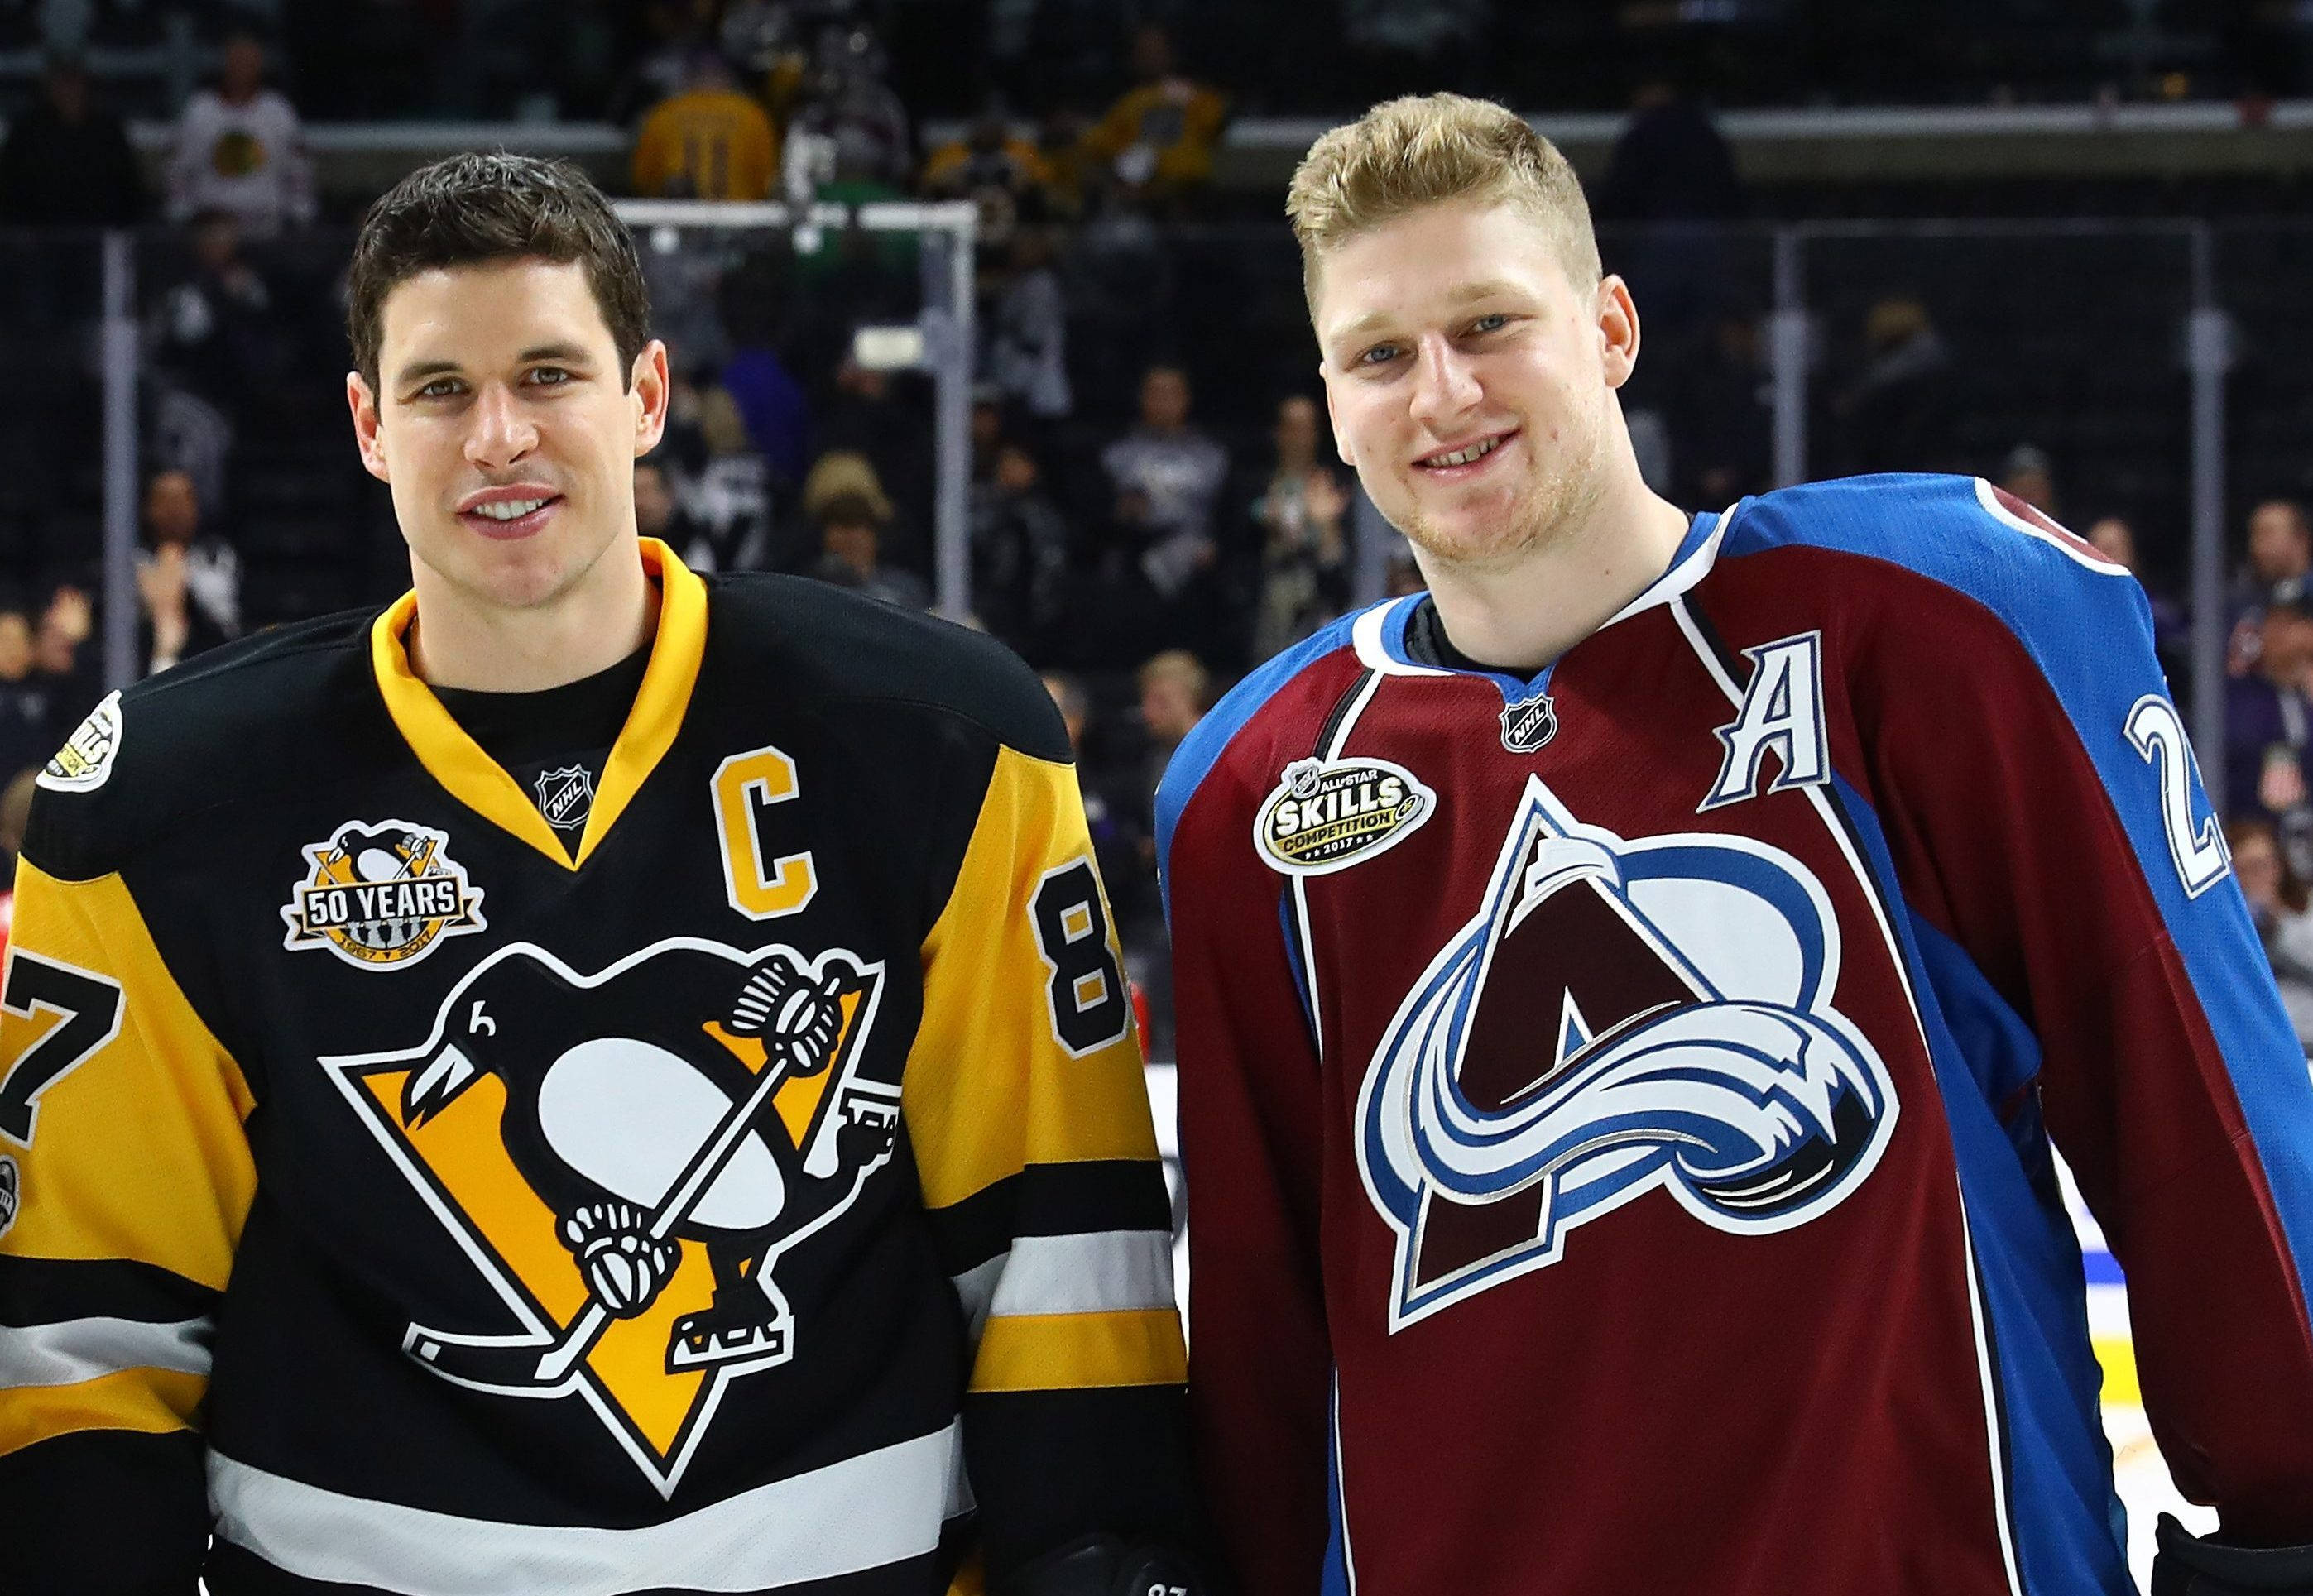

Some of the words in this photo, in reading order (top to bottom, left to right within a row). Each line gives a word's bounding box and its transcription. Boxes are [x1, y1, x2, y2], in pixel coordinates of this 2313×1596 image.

[1514, 707, 1545, 744] NHL
[1696, 629, 1831, 814] A
[552, 781, 583, 818] NHL
[1275, 776, 1404, 836] SKILLS
[709, 745, 818, 922] C
[1283, 811, 1390, 853] COMPETITION
[1324, 836, 1355, 855] 2017
[307, 889, 348, 925] 50
[356, 880, 456, 920] YEARS
[399, 929, 431, 957] 2017
